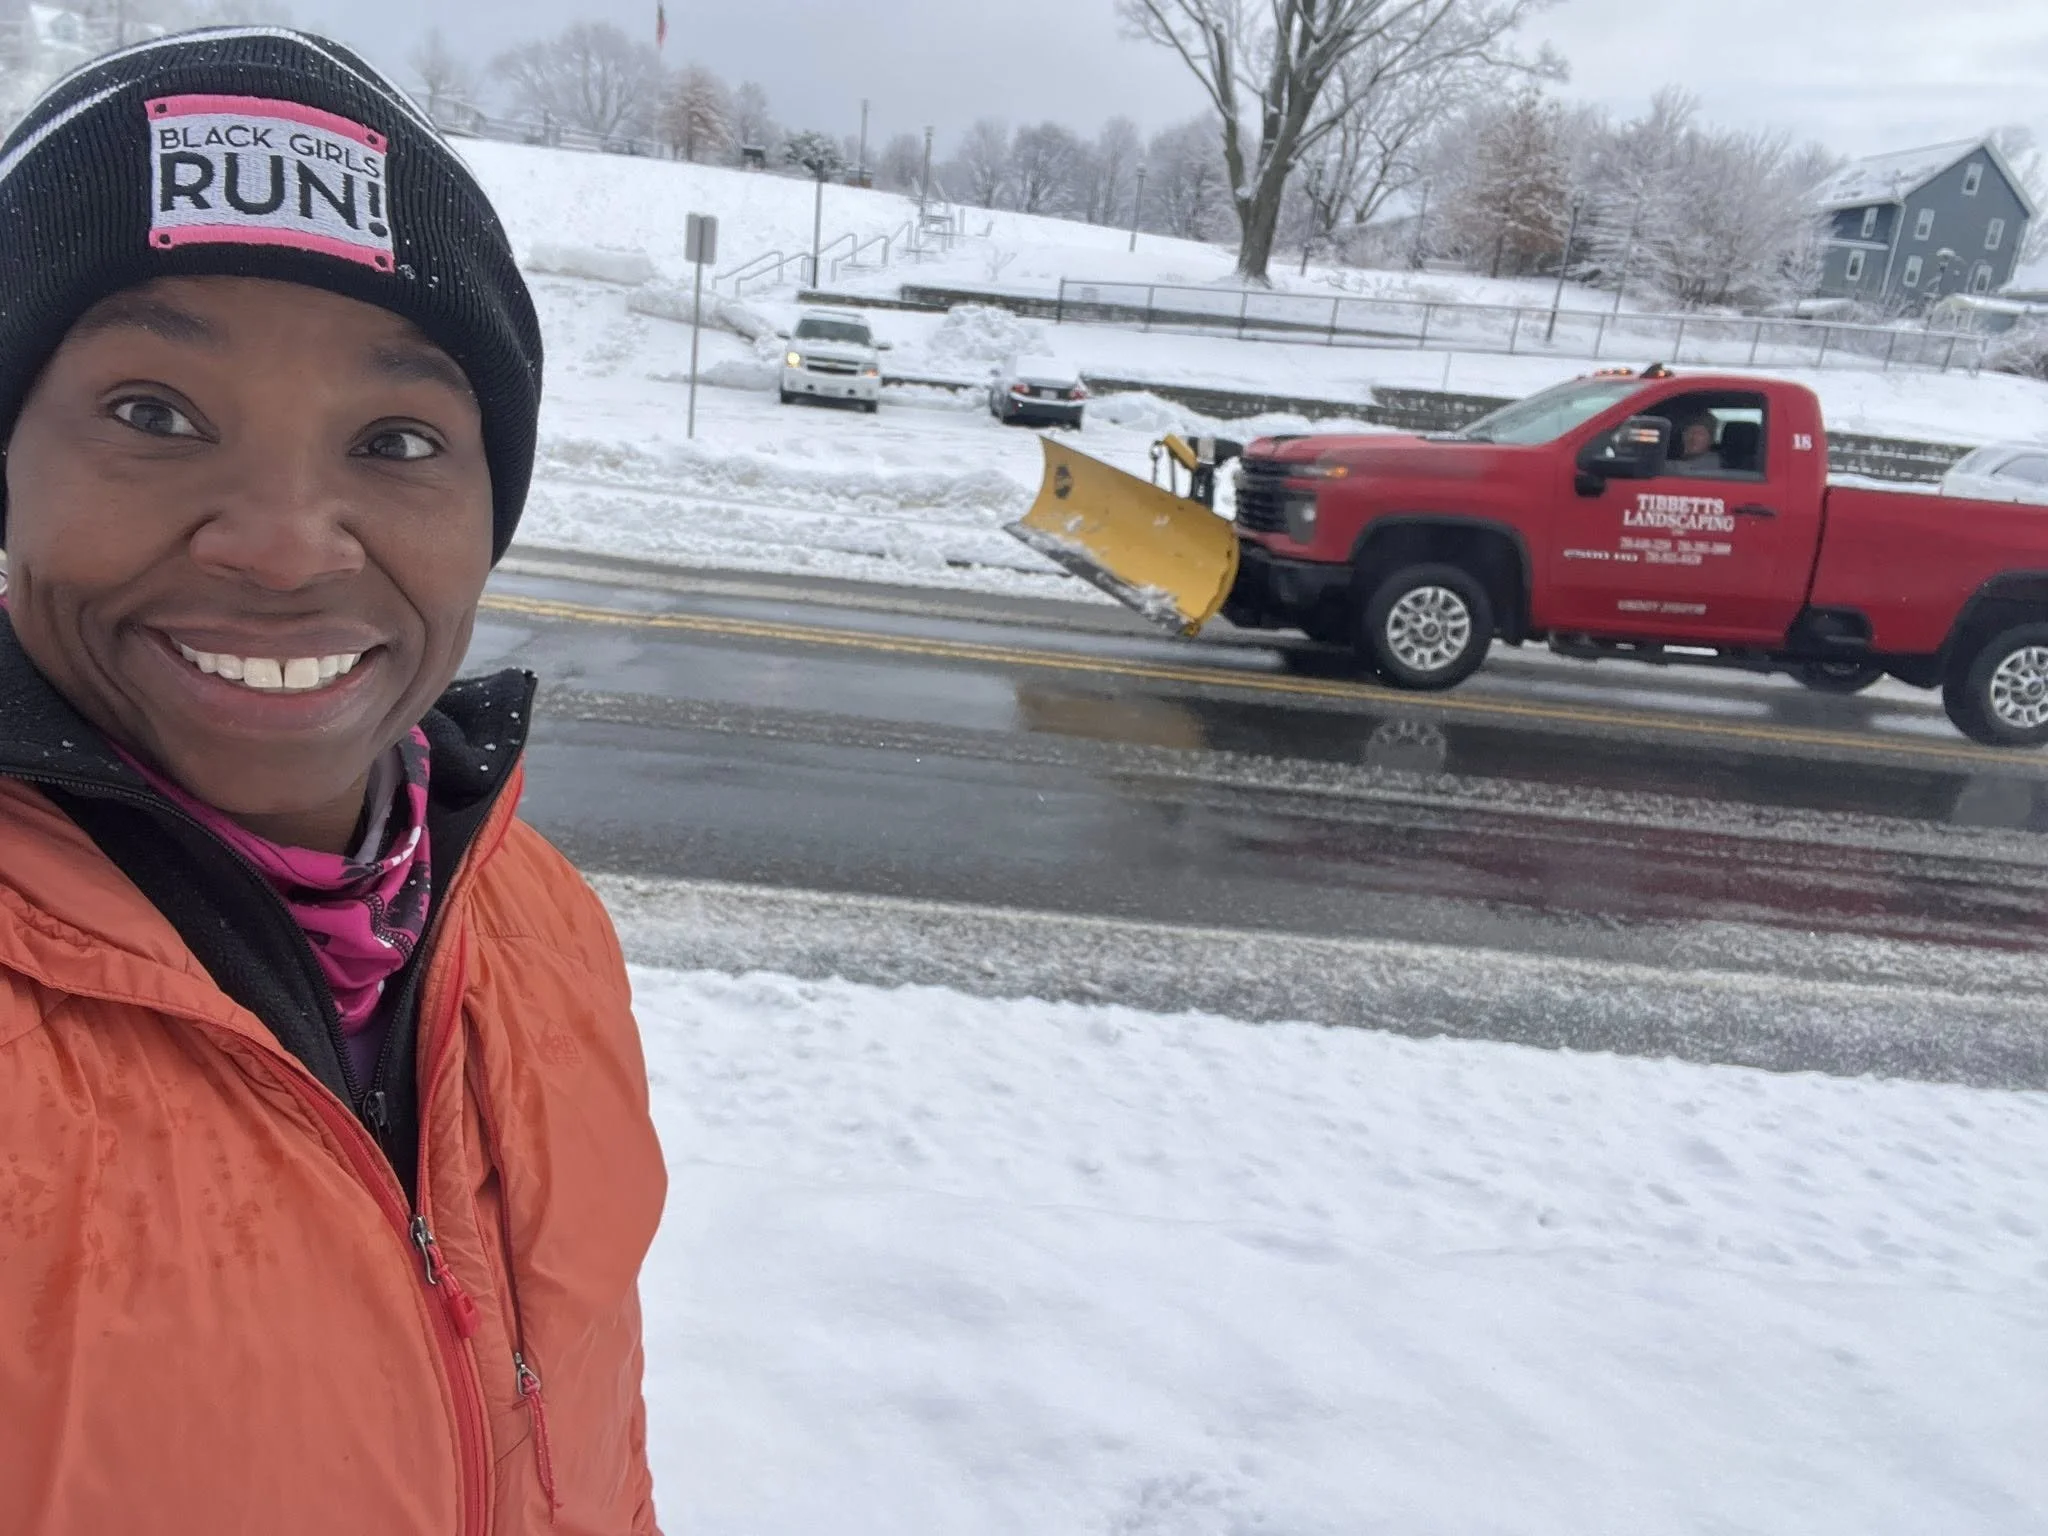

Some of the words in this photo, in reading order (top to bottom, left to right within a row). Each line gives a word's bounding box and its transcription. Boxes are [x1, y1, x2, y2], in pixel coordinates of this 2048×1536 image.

[160, 125, 272, 150] BLACK
[289, 133, 381, 179] GIRLS
[159, 150, 389, 238] RUN!
[1792, 433, 1812, 450] 18
[1636, 493, 1725, 515] TIBBETTS
[1623, 509, 1735, 532] LANDSCAPING
